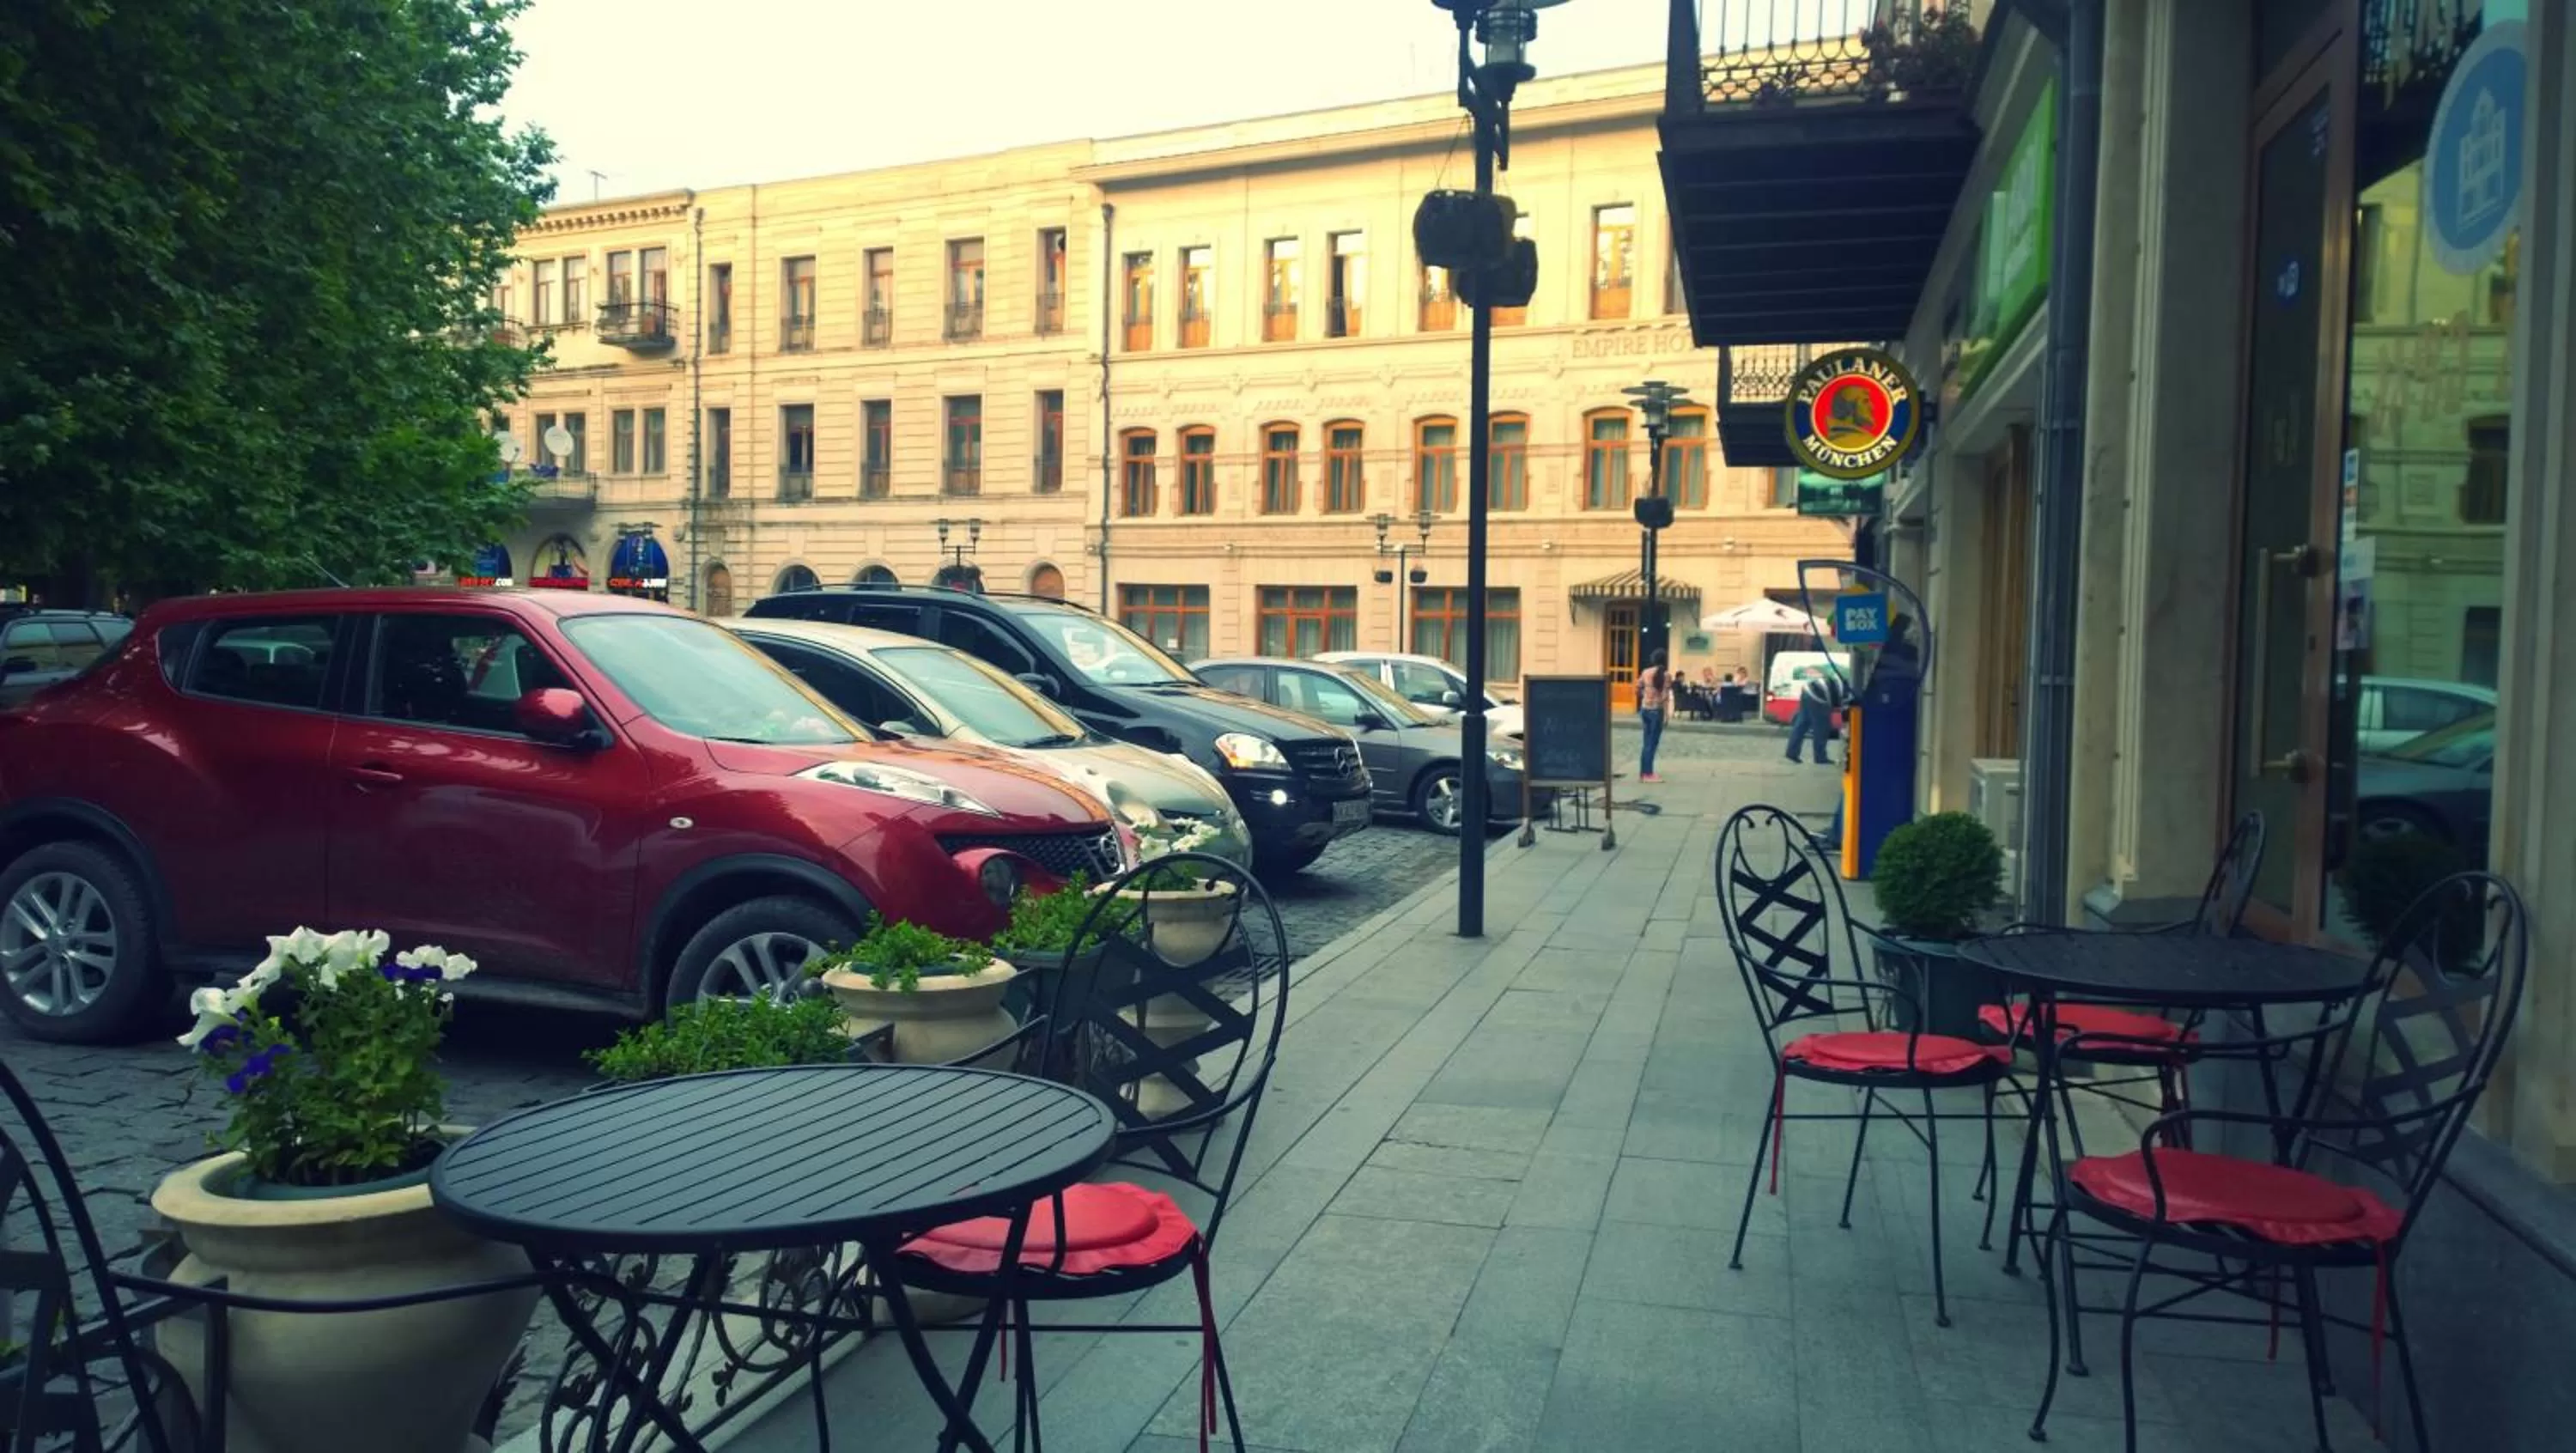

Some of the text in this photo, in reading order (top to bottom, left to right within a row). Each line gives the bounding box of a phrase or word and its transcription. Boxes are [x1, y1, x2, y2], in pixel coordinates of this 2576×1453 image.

[1572, 336, 1647, 359] EMPIRE
[1798, 356, 1908, 405] PAULANER
[1845, 607, 1878, 619] PAY
[1845, 619, 1878, 631] BOX
